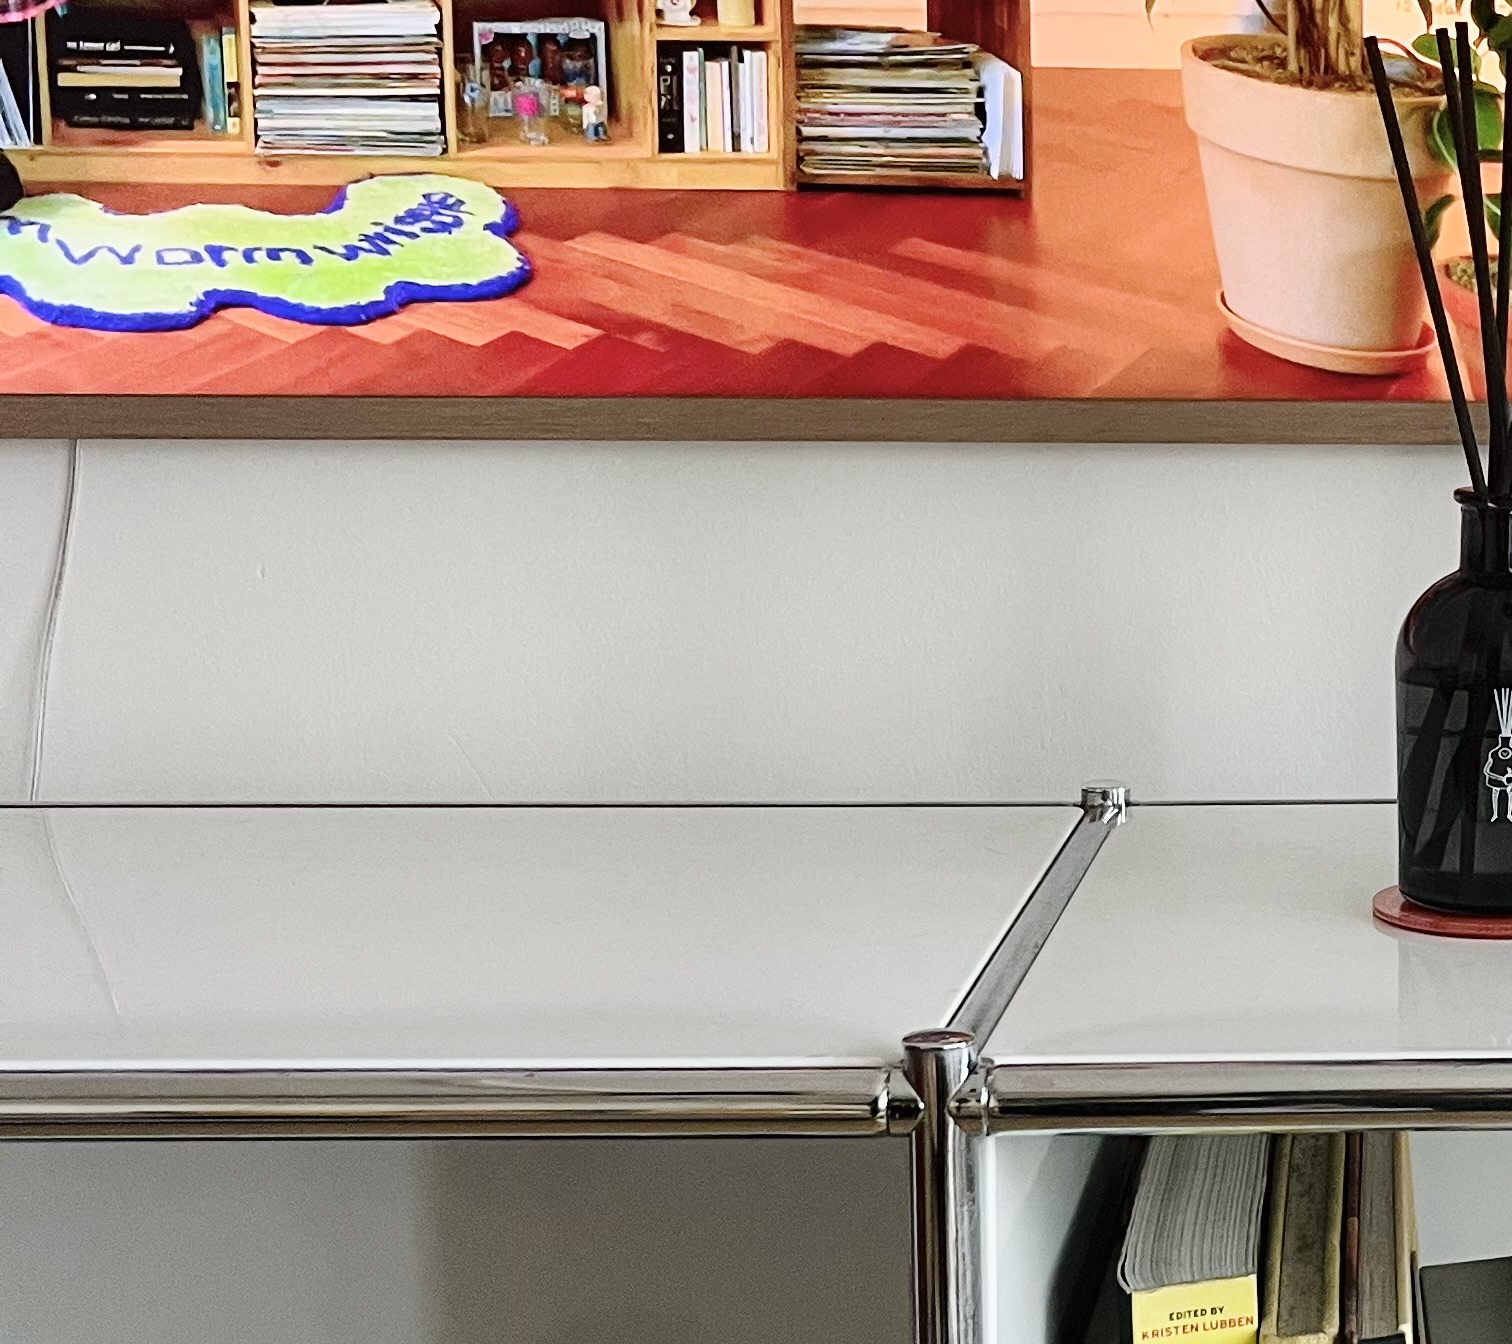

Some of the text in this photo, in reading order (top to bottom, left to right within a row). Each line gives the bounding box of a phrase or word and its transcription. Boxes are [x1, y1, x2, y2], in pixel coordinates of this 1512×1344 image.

[1169, 1306, 1225, 1321] EDITED BY
[1141, 1315, 1254, 1341] KRISTEN LUBBEN
